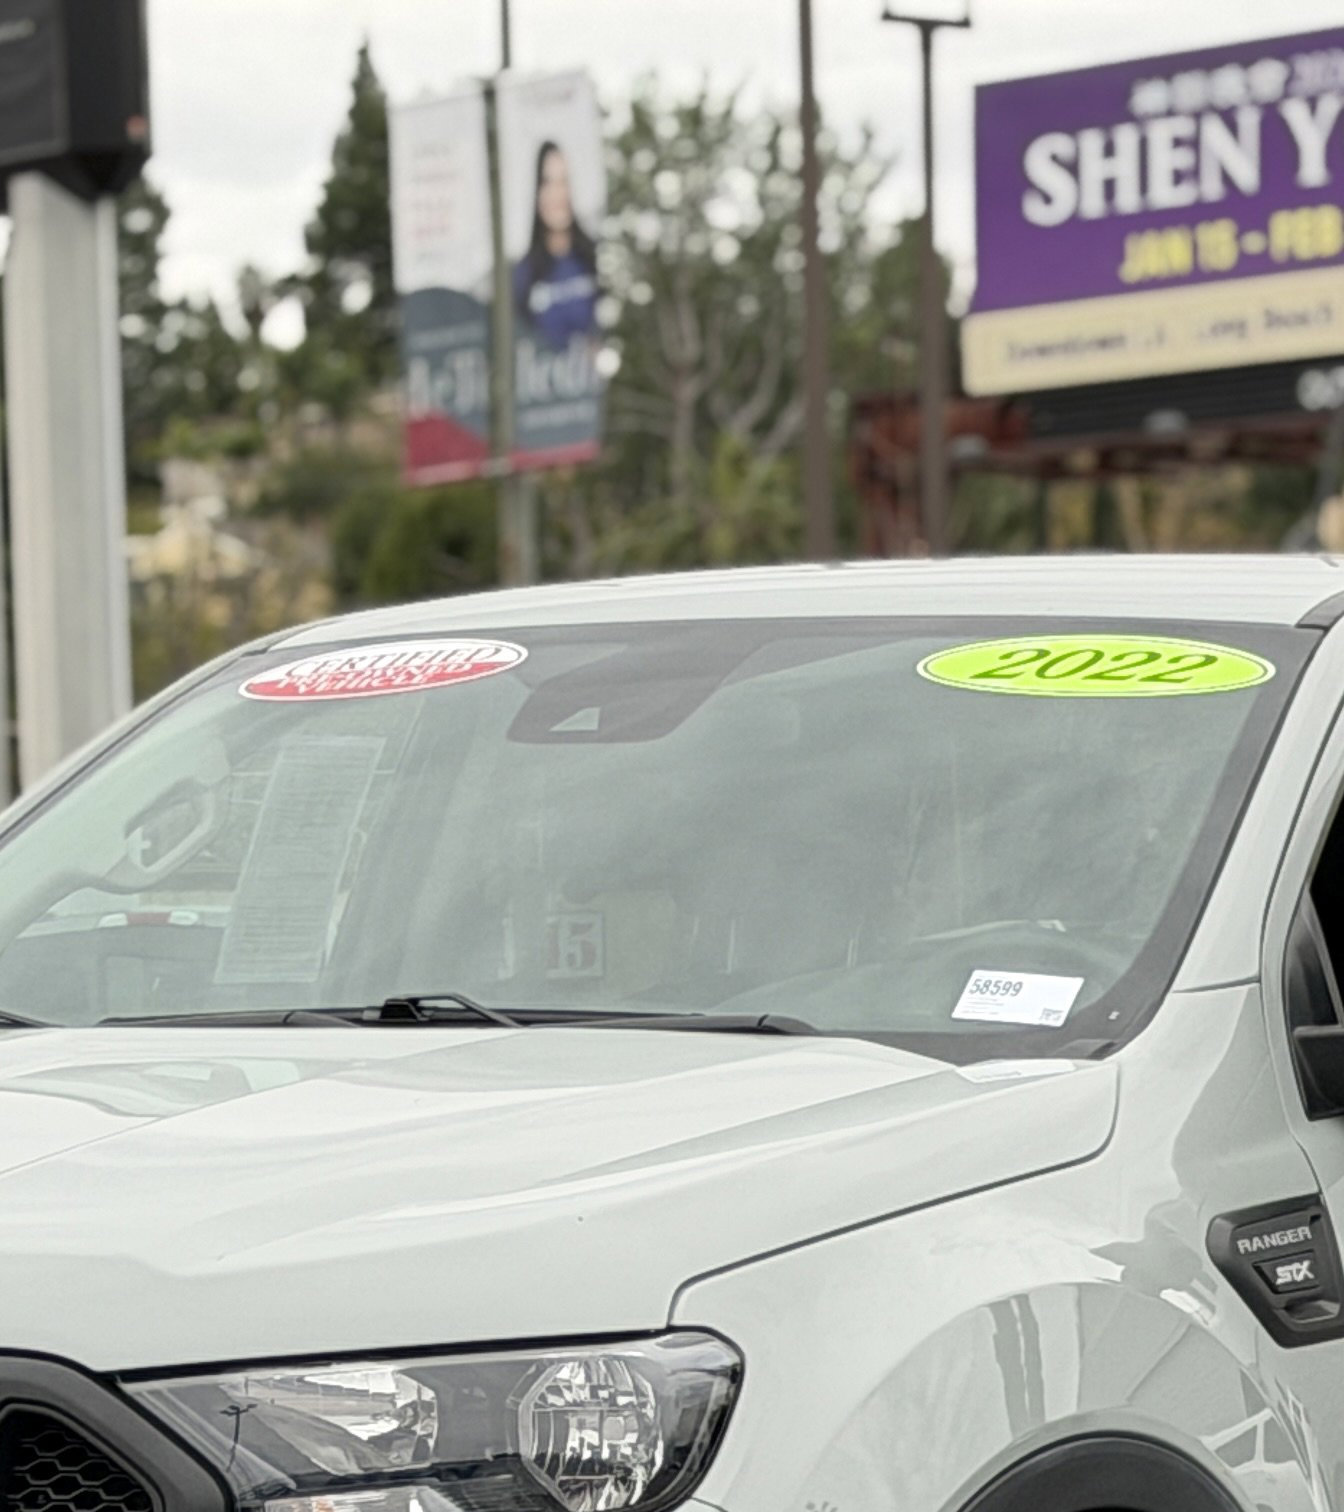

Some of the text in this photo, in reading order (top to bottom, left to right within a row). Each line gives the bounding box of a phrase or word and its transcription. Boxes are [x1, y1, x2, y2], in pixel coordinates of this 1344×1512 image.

[1021, 104, 1264, 228] SHEN
[1118, 225, 1194, 284] JAN
[1267, 203, 1344, 263] FEB
[286, 646, 504, 677] CERTIFIED
[968, 648, 1219, 684] 2022
[968, 978, 1024, 998] 58599
[1236, 1225, 1313, 1255] RANGER
[1275, 1259, 1315, 1286] STX
